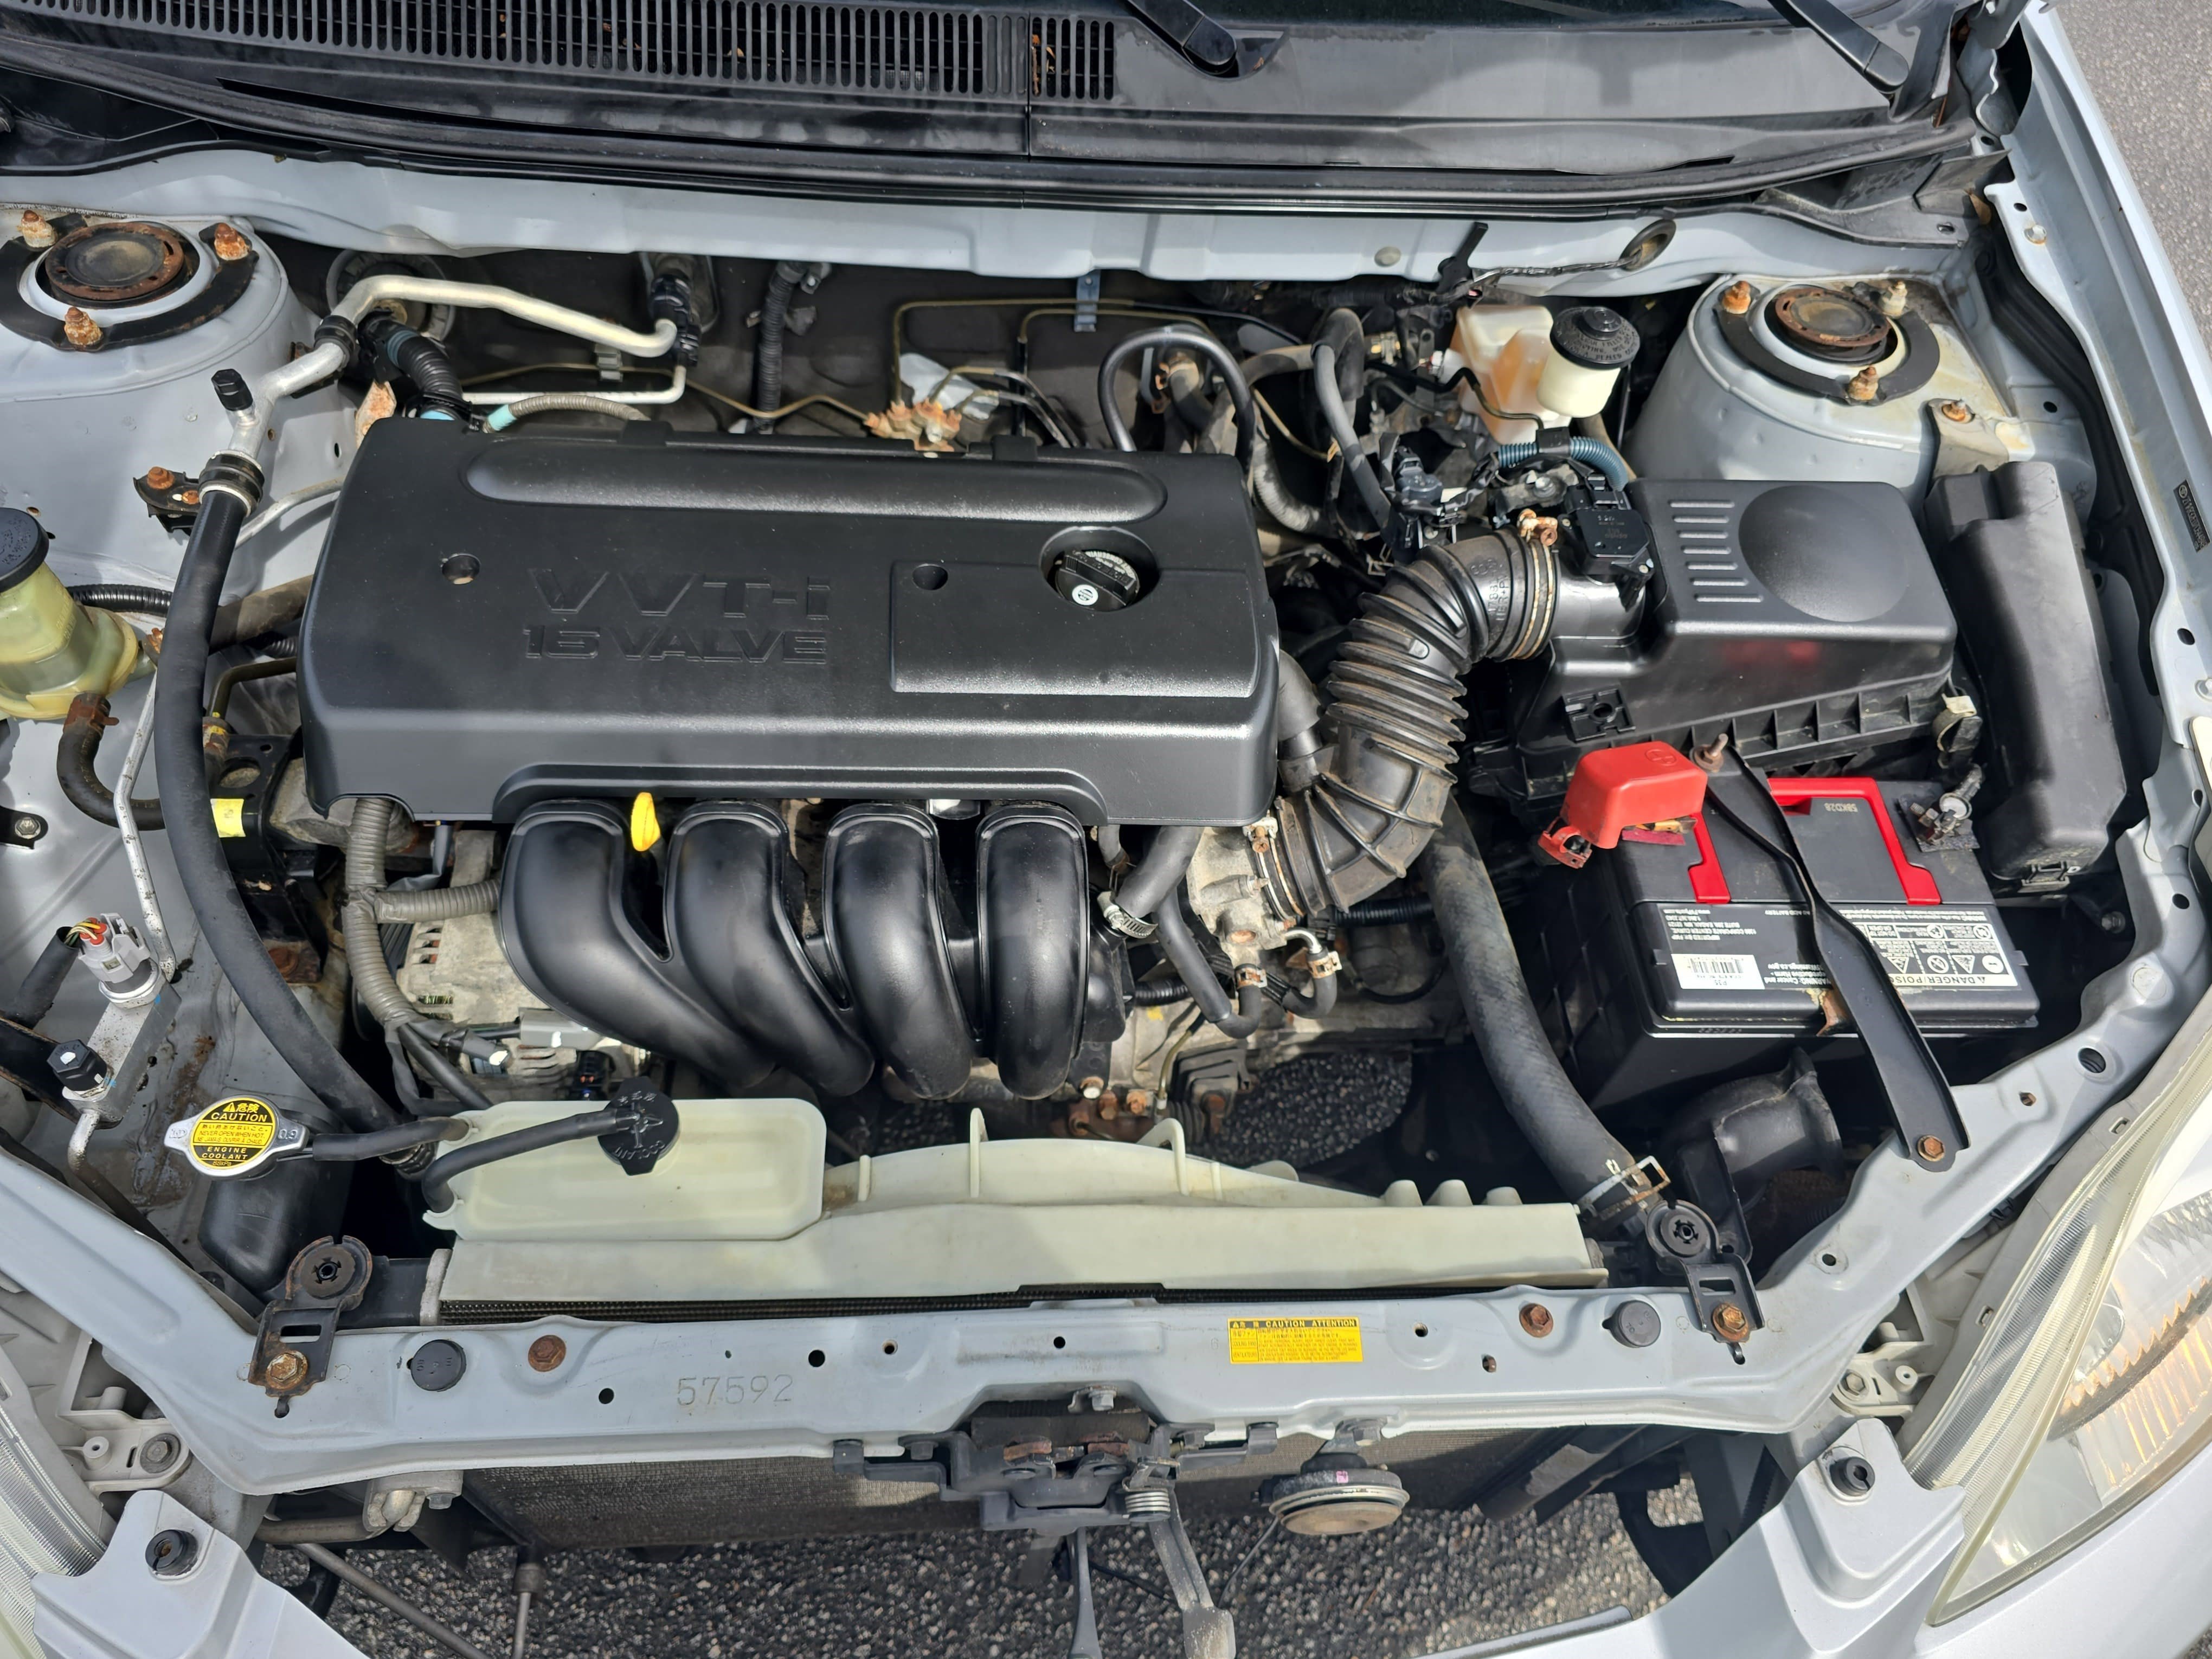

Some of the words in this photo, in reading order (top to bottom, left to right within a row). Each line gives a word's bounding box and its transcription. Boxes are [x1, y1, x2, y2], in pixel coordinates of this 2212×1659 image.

[522, 627, 601, 658] 16
[616, 627, 827, 665] VALVE
[1777, 976, 1799, 985] Cancer
[236, 1103, 260, 1113] 危険
[211, 1112, 268, 1122] CAUTION
[1265, 1320, 1306, 1328] CAUTION
[1311, 1319, 1355, 1327] ATTENTION
[677, 1373, 794, 1406] 57592
